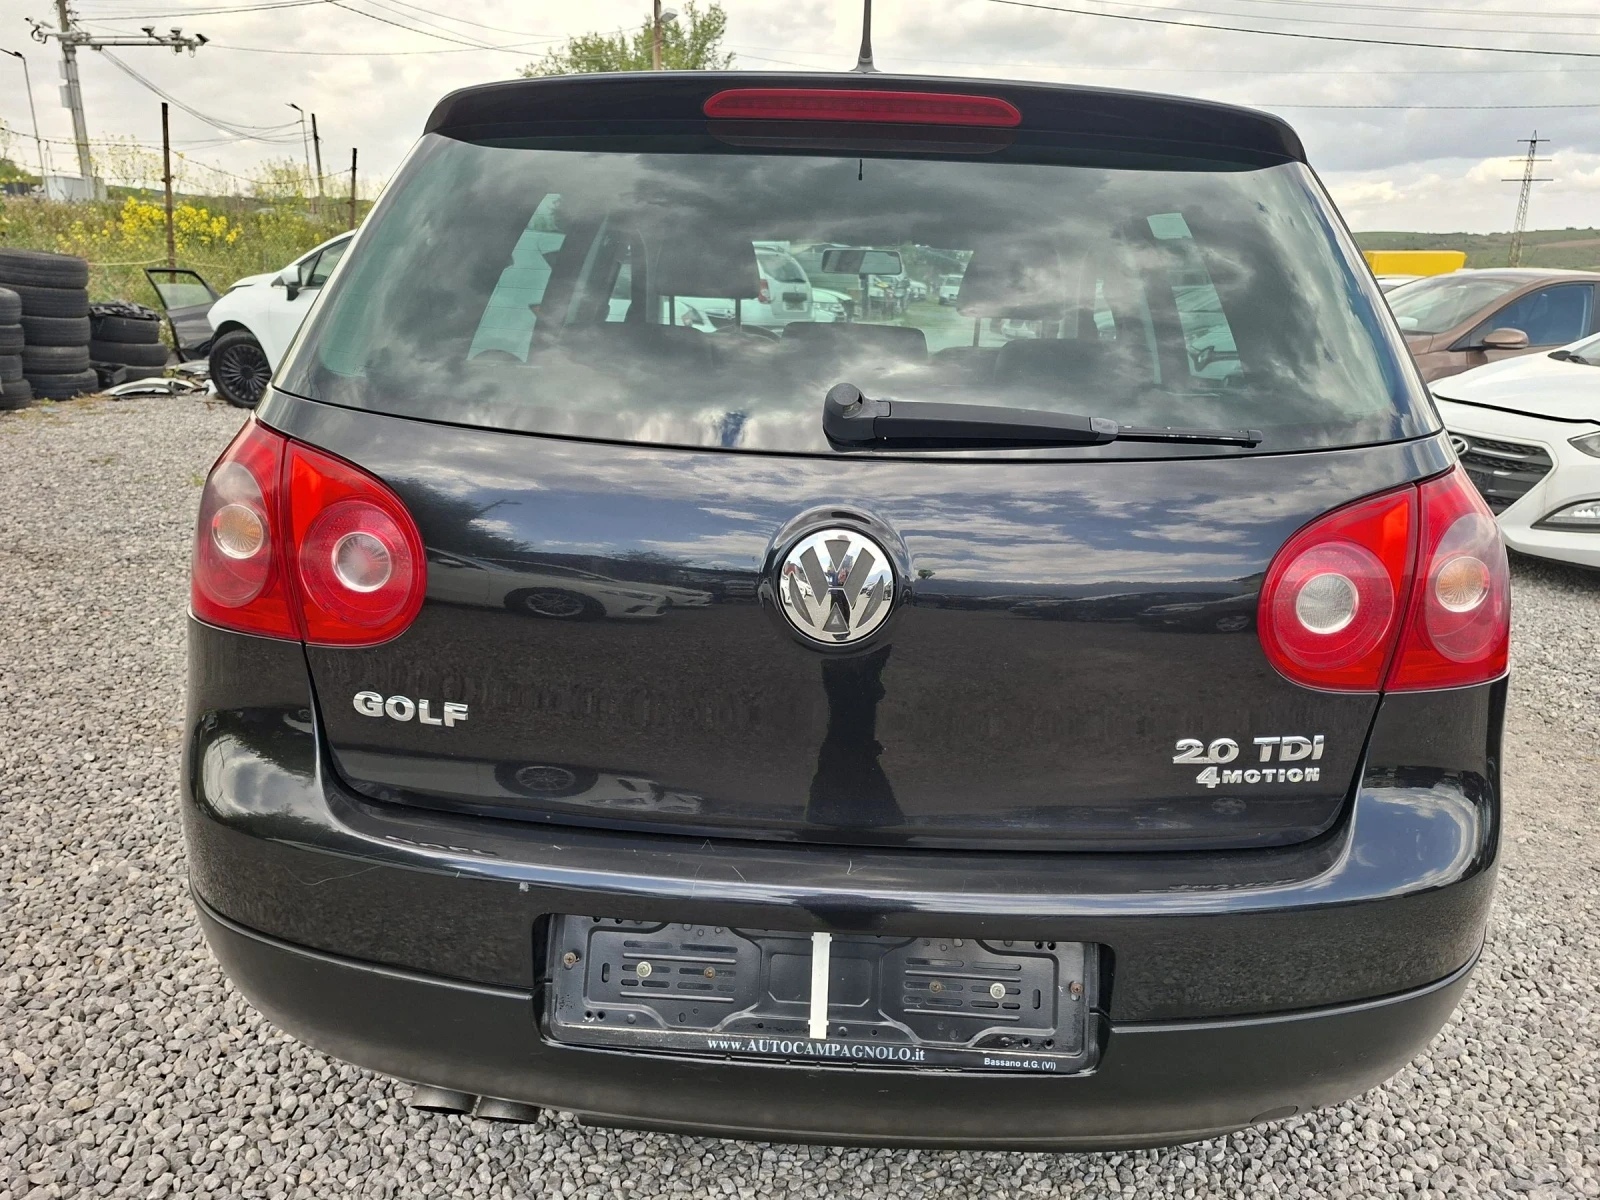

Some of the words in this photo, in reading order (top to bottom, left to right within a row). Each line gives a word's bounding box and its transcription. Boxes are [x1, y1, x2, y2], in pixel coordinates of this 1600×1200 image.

[353, 690, 469, 728] GOLF
[1253, 734, 1325, 763] TDI
[707, 1038, 925, 1062] www.AUTOCAMPAGNOLO.it
[984, 1057, 1021, 1068] Bassano
[1023, 1060, 1040, 1069] d.G.
